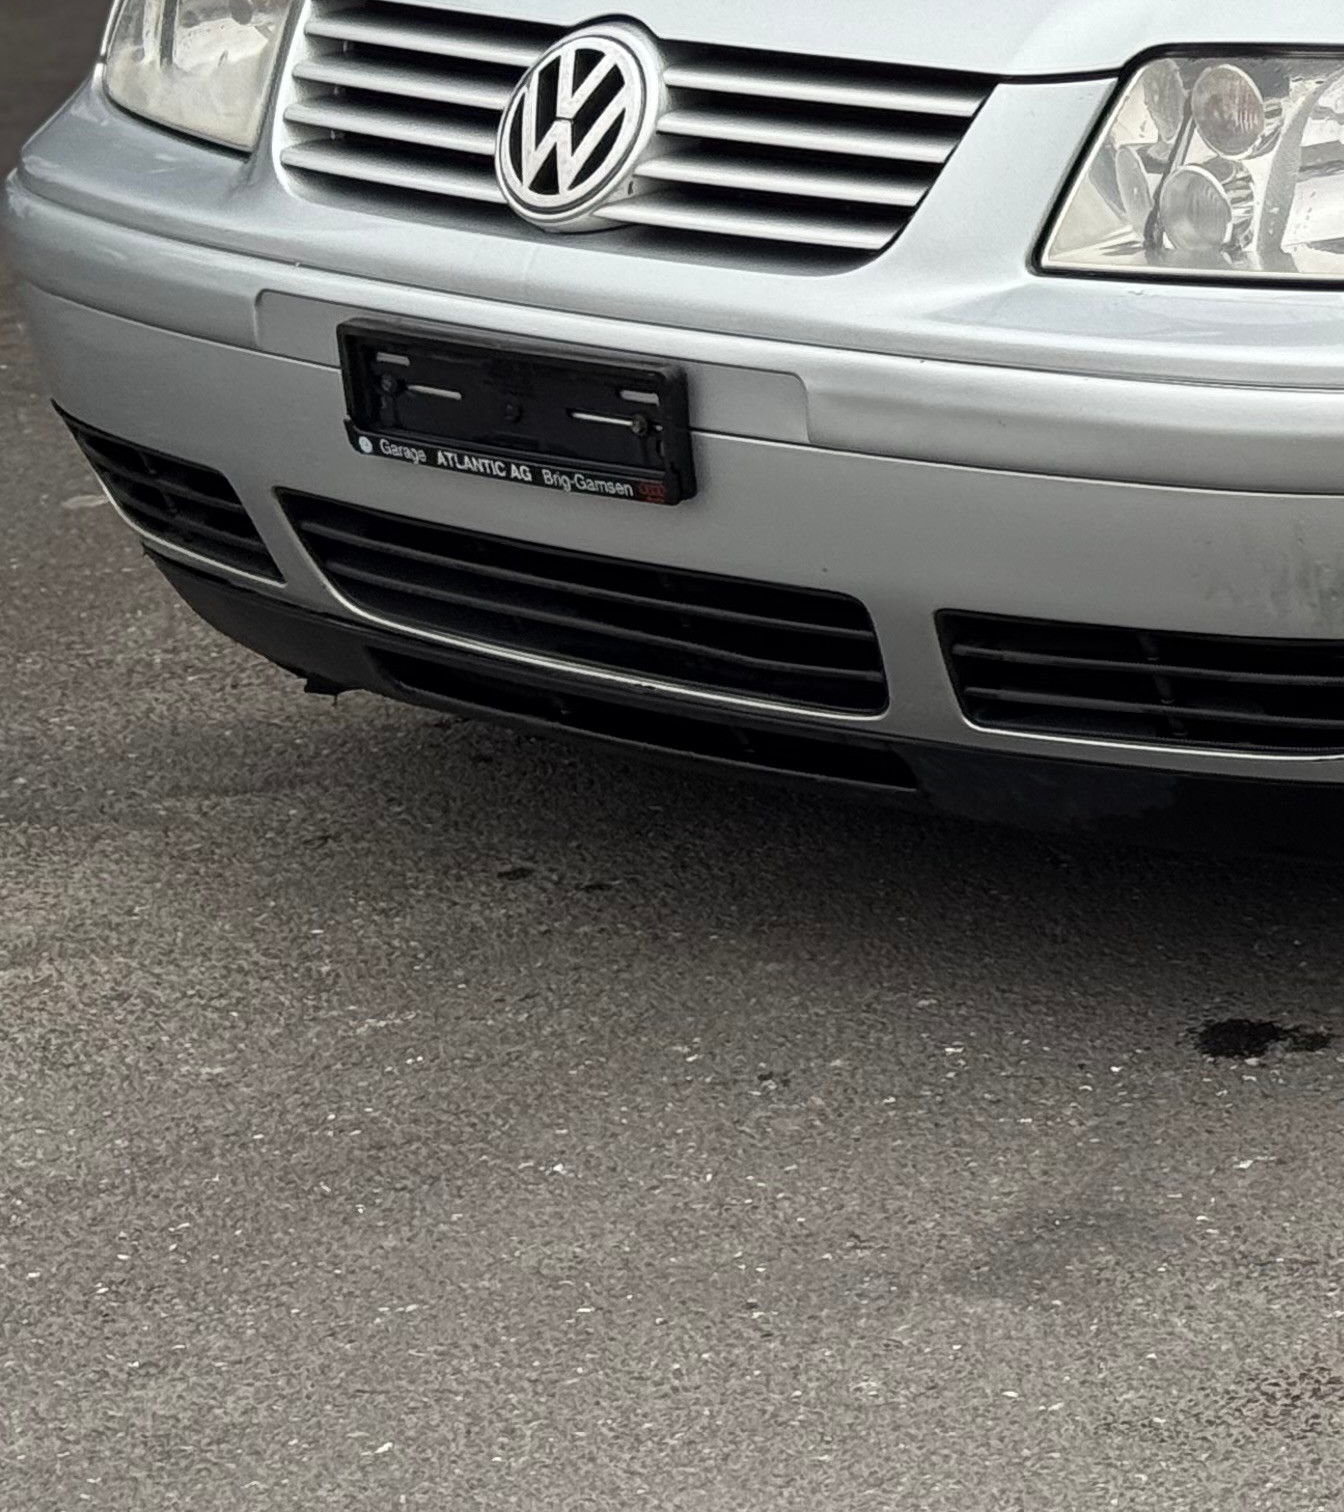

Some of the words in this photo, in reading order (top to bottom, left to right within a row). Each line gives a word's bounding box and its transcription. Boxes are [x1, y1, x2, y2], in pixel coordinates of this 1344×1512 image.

[500, 37, 645, 212] VW
[379, 438, 427, 464] Garage
[437, 450, 506, 477] ATLANTIC
[510, 463, 532, 481] AG
[542, 468, 634, 497] Brig-Gamsen
